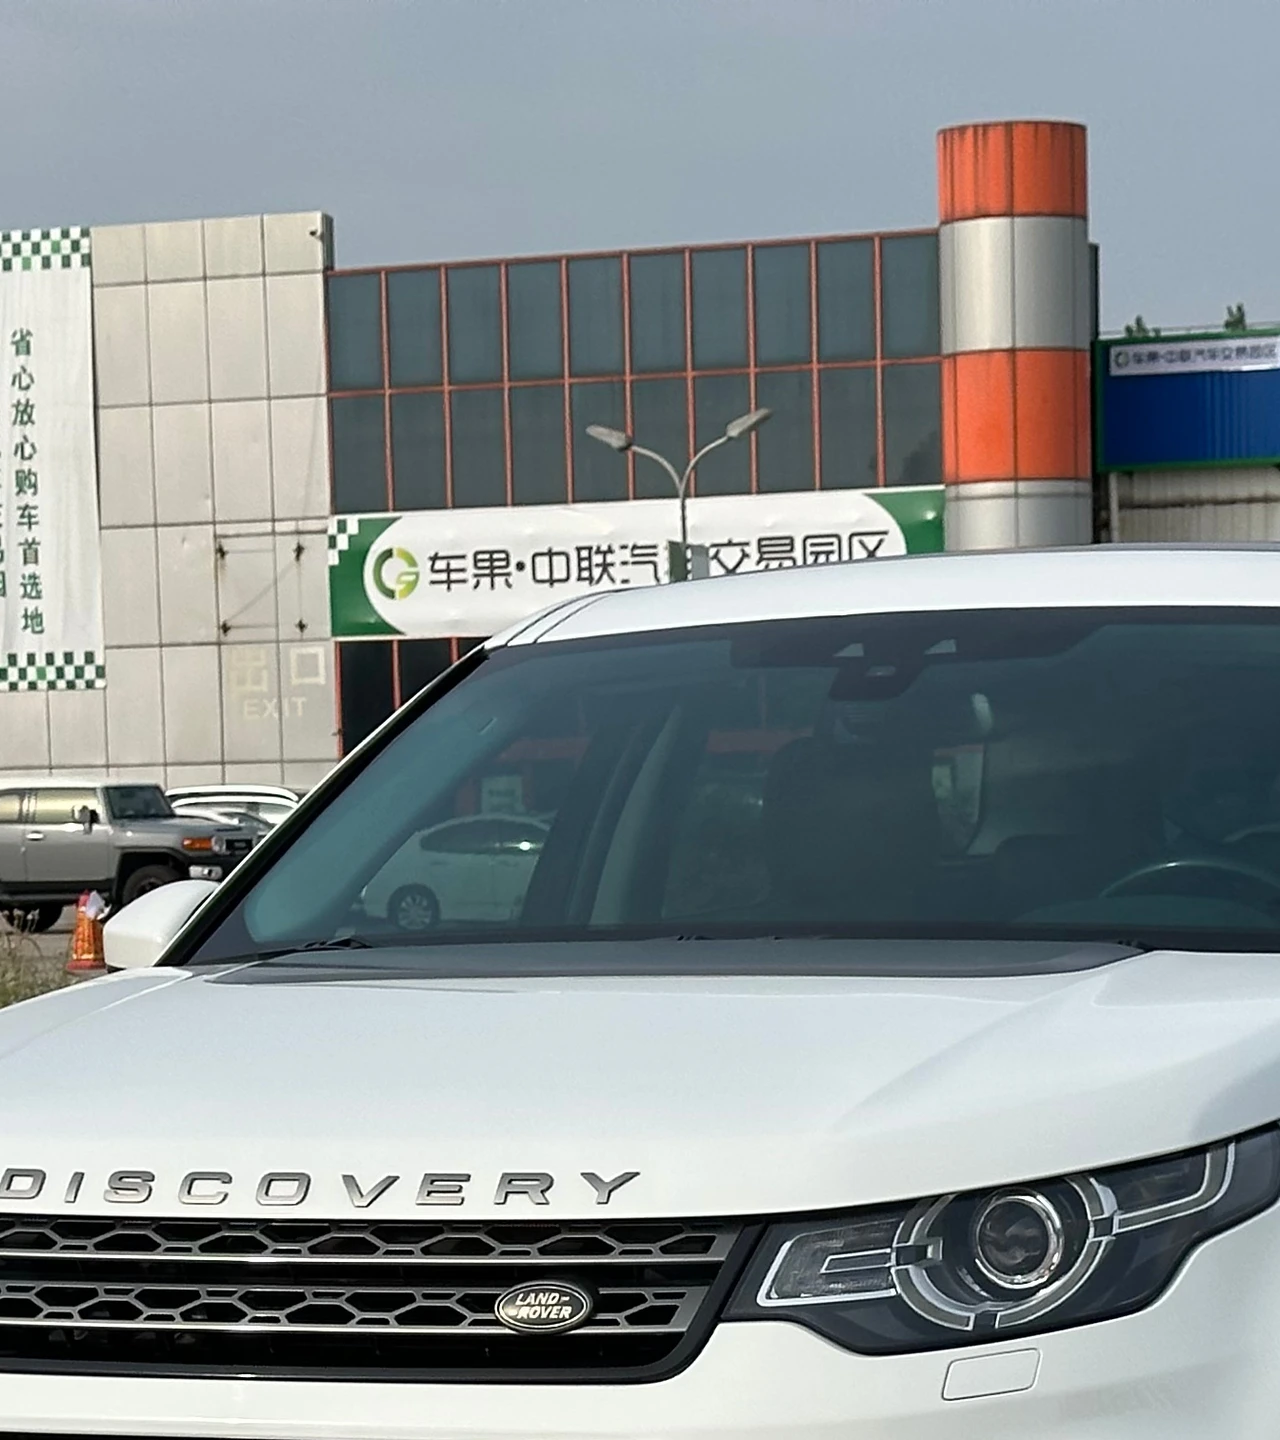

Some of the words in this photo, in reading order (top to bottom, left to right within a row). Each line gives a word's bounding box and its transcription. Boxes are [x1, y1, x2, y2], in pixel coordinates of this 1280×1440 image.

[10, 327, 45, 635] 省心放心购车首选地
[428, 530, 889, 592] 车果·中联汽交易园区
[516, 1305, 572, 1320] ROVER
